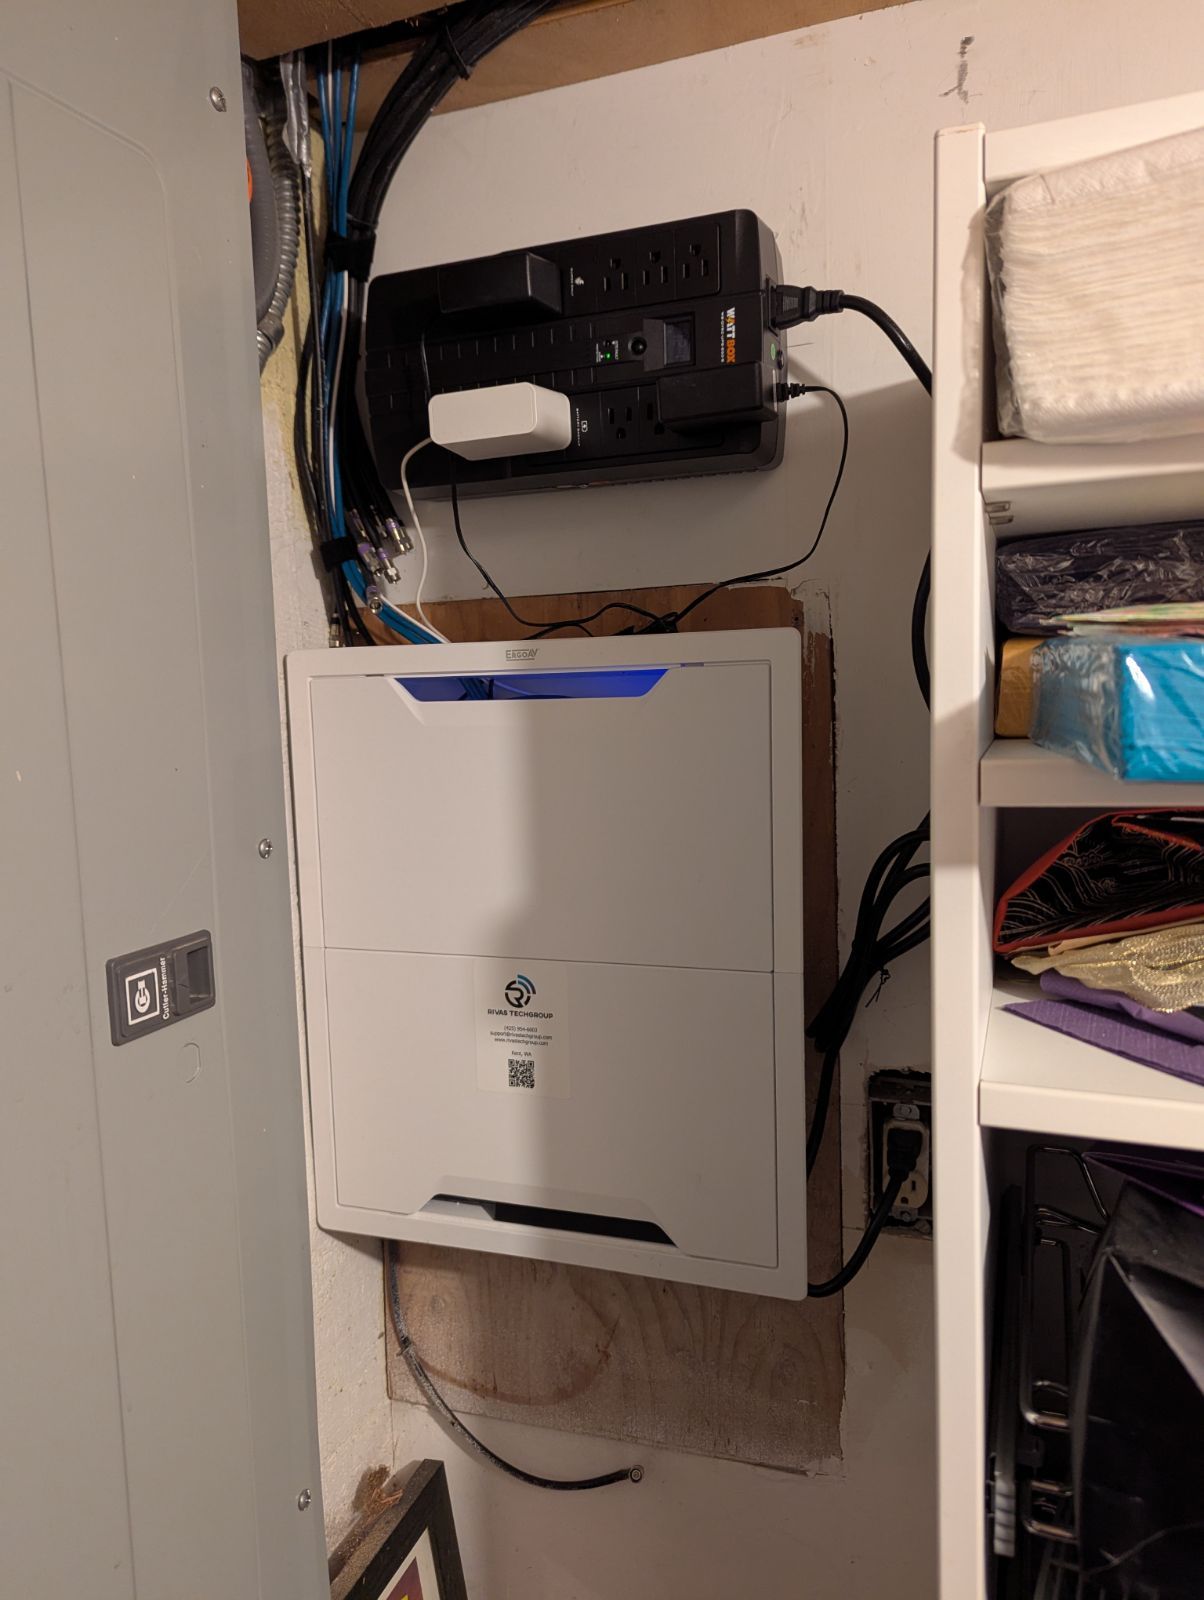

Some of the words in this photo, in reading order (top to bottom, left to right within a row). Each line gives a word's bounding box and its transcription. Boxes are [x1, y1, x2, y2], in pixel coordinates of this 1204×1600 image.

[160, 956, 170, 1020] Cutler-Hammer
[487, 1008, 508, 1016] RIVAS
[509, 1010, 554, 1019] TECHGROUP
